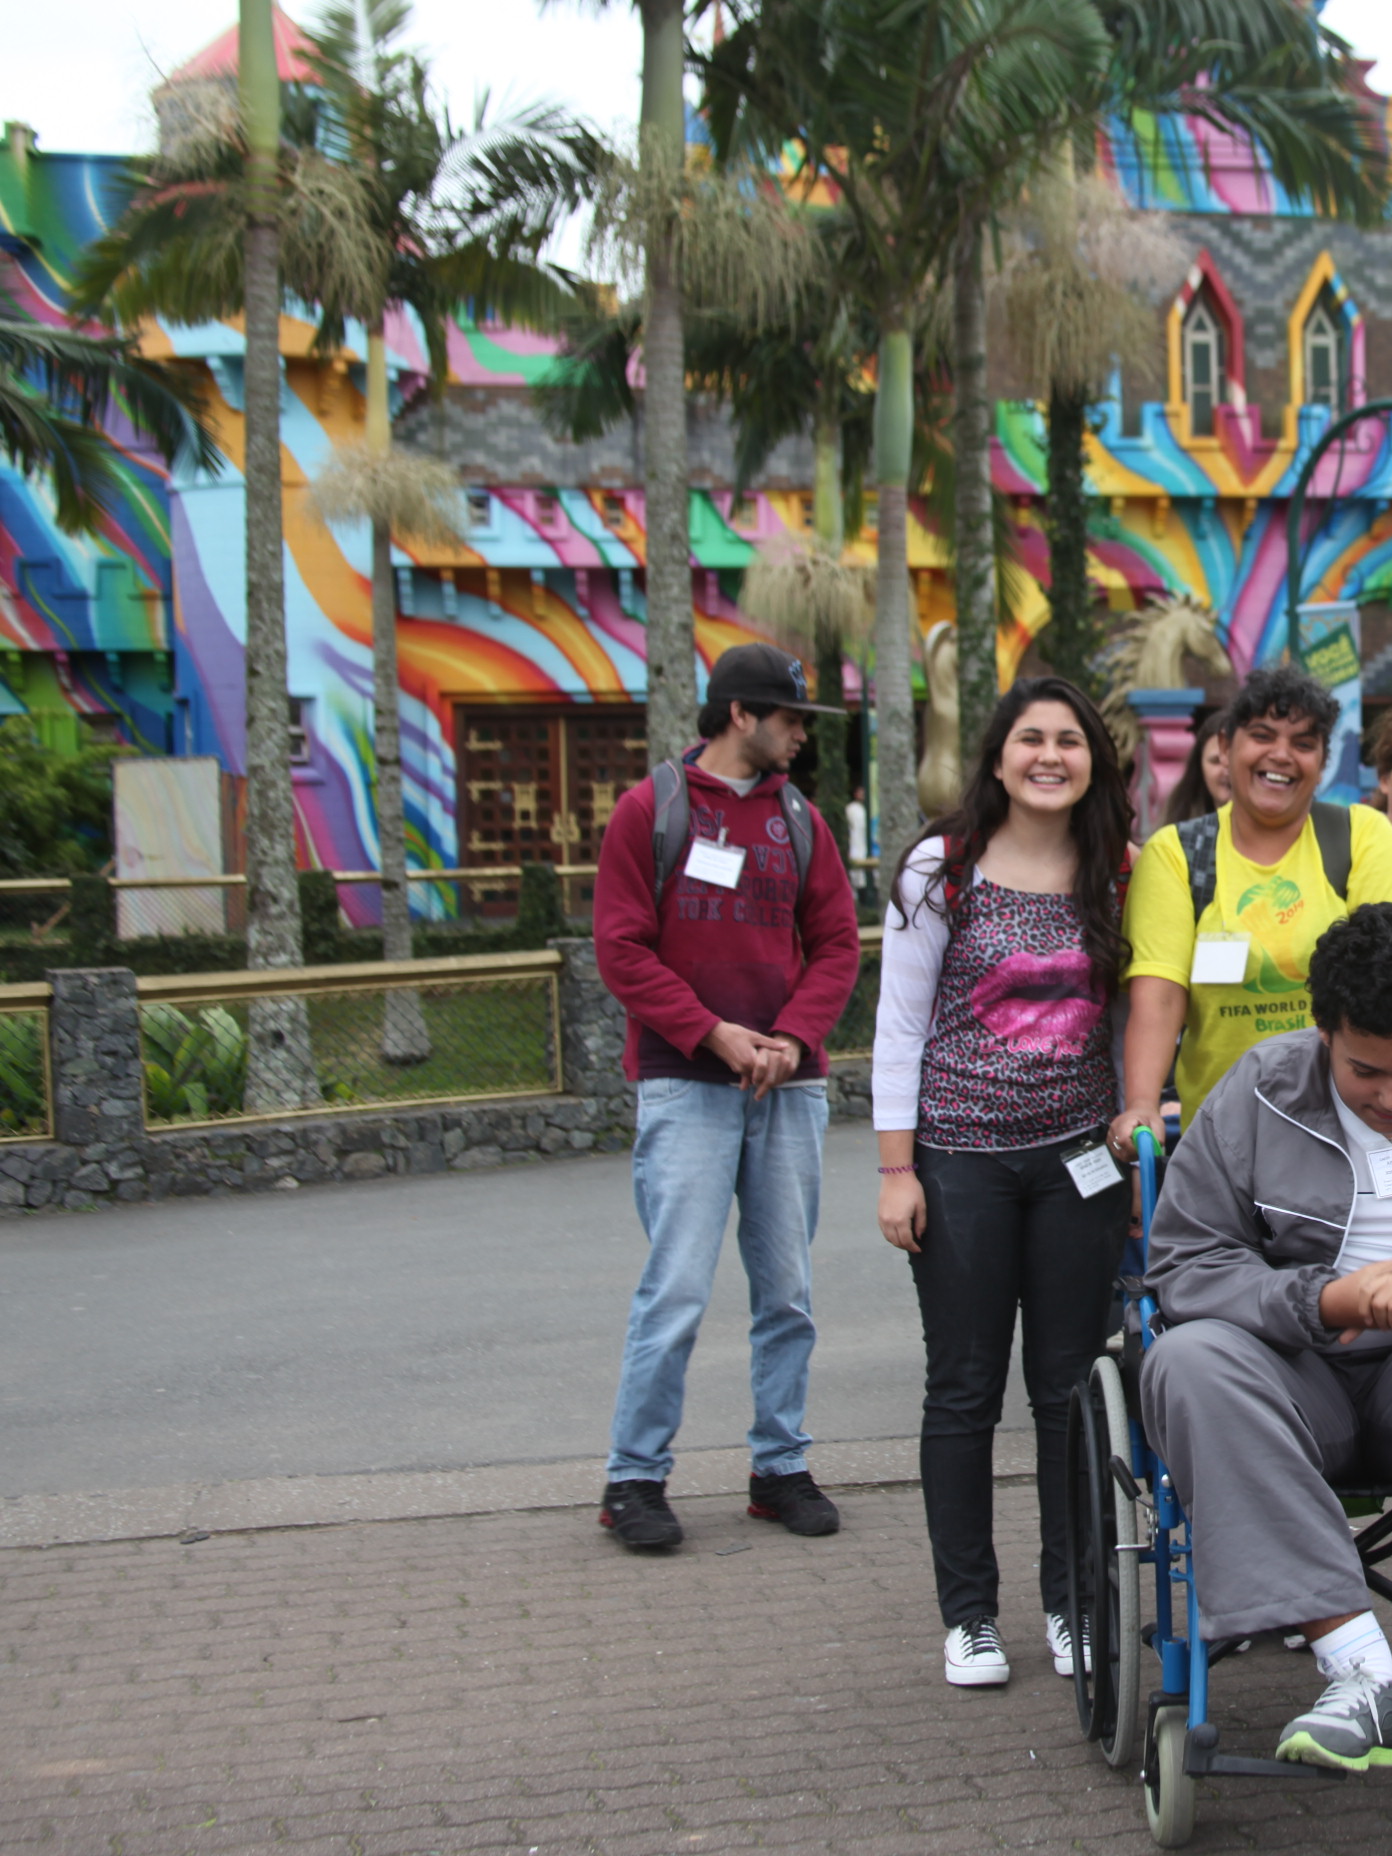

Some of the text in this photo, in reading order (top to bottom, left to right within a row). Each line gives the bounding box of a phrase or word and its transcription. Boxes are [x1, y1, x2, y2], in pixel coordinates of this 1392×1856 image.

[1274, 898, 1305, 925] 2014
[1219, 999, 1307, 1017] FIFA WORLD
[1255, 1014, 1306, 1032] Brasil
